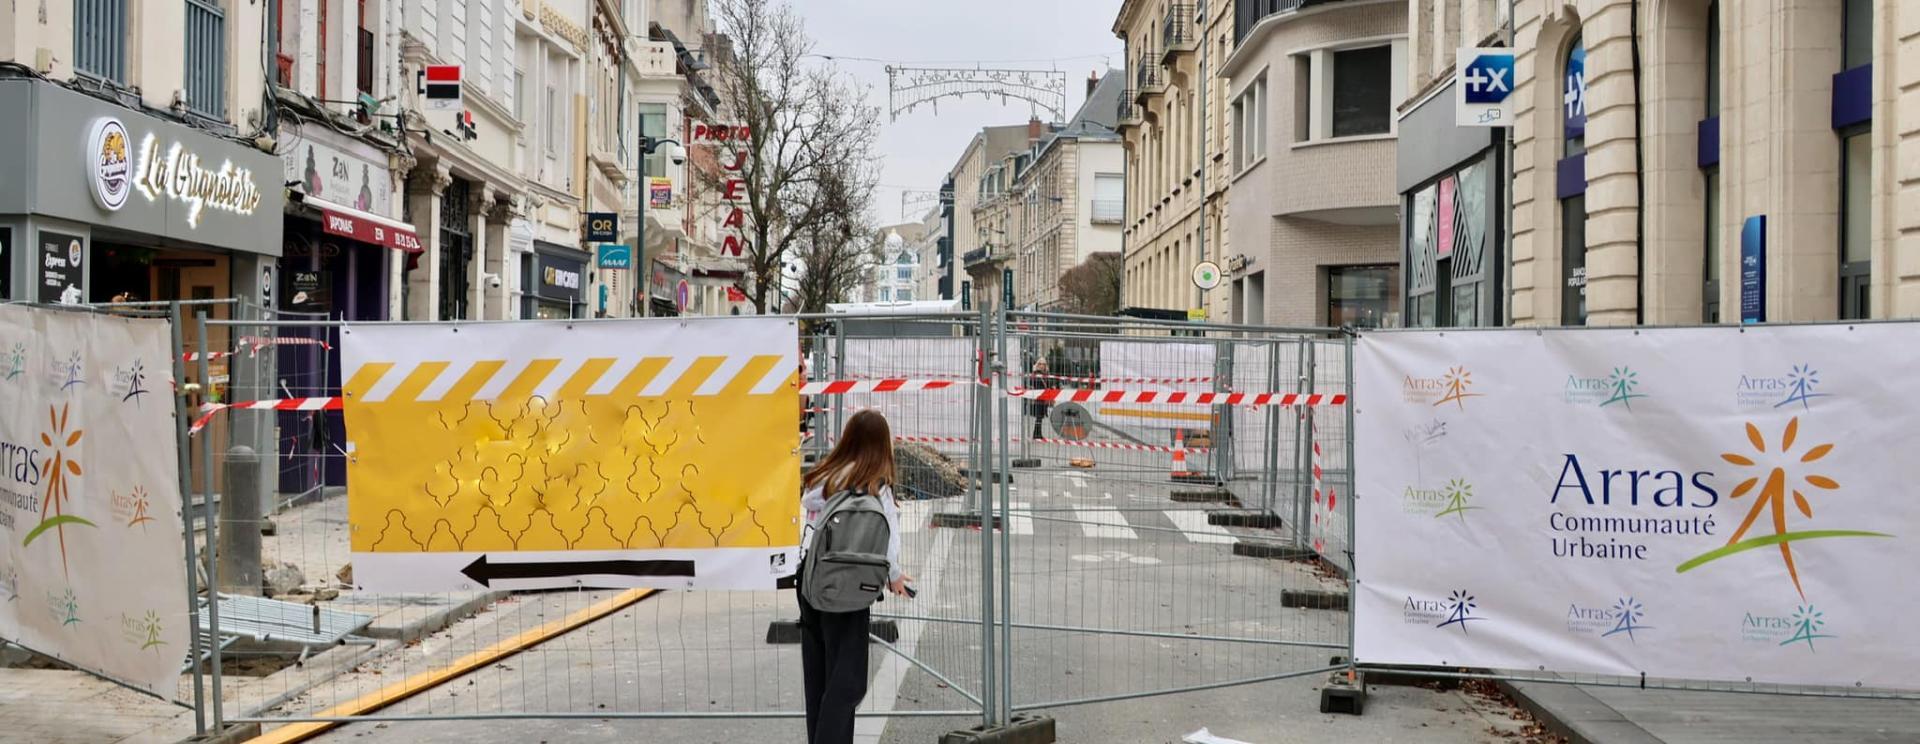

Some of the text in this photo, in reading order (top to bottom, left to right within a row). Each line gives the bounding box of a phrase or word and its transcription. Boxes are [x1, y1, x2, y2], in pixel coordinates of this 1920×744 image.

[694, 124, 750, 141] PHOTO
[134, 133, 262, 229] La Grignoterie
[720, 151, 748, 257] JEAN
[592, 219, 613, 231] OR
[1404, 375, 1443, 390] Arras
[1567, 375, 1609, 390] Arras
[1738, 375, 1786, 390] Arras
[0, 441, 39, 485] rras
[1550, 453, 1719, 508] Arras
[1404, 486, 1445, 501] Arras
[1550, 512, 1716, 536] Communauté
[1552, 536, 1648, 560] Urbaine
[1404, 596, 1447, 611] Arras
[1568, 604, 1613, 620] Arras
[1742, 612, 1791, 628] Arras
